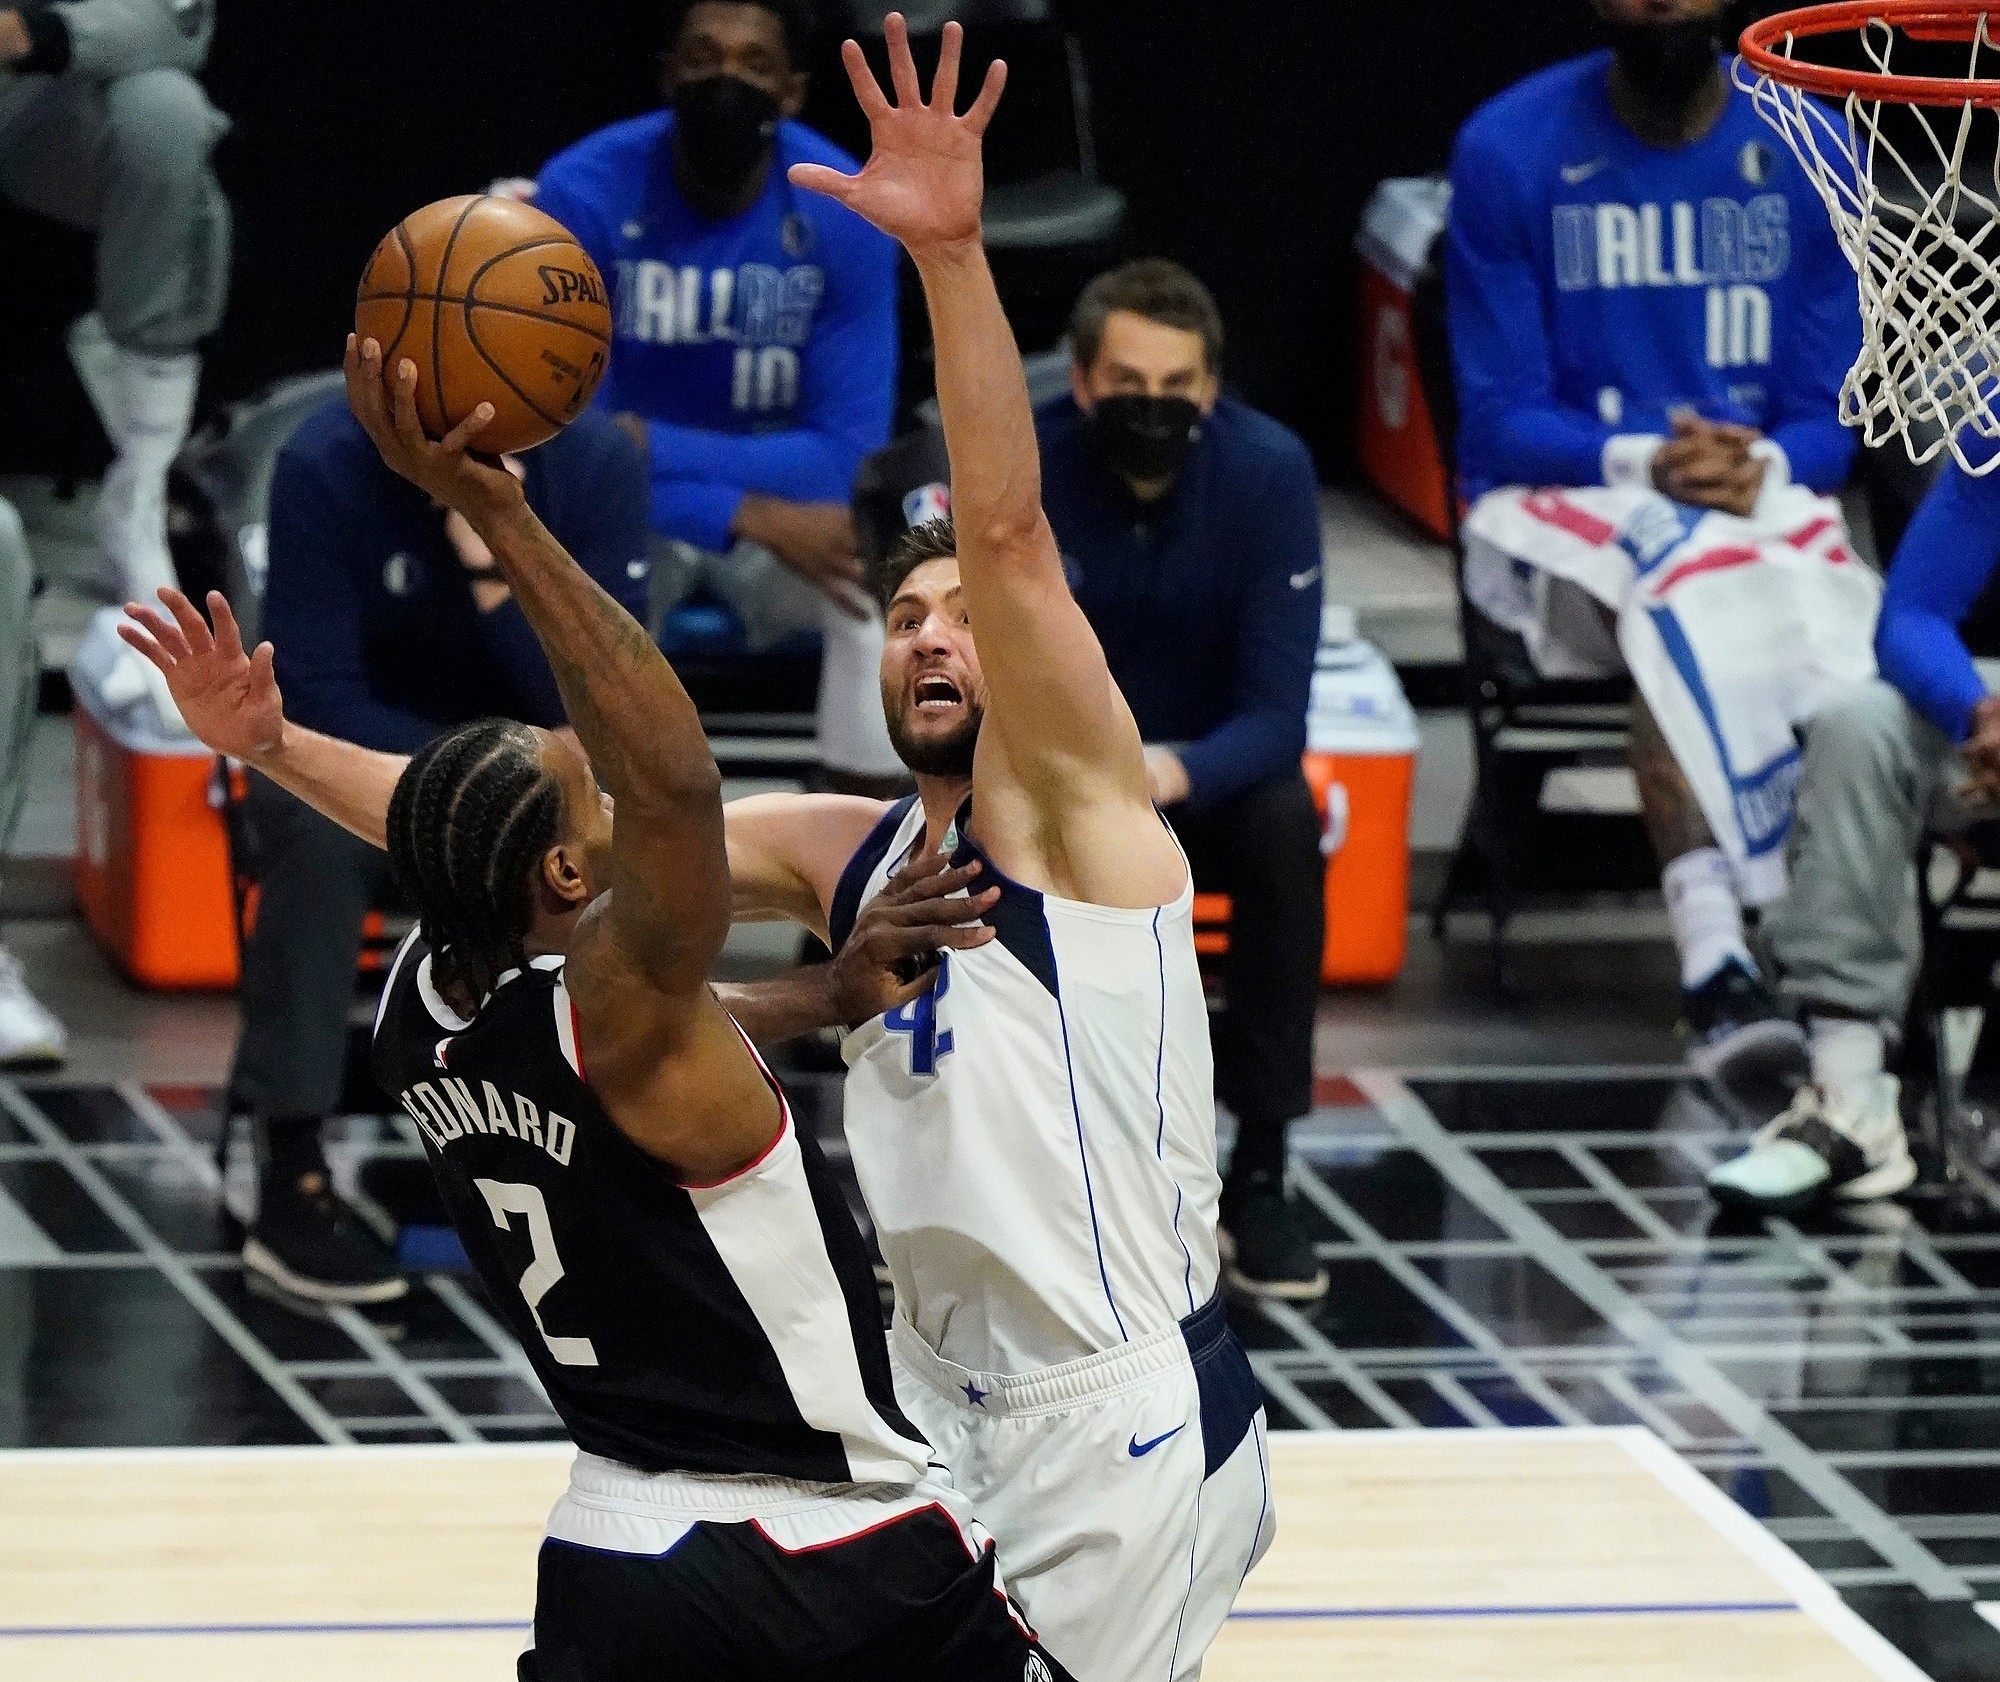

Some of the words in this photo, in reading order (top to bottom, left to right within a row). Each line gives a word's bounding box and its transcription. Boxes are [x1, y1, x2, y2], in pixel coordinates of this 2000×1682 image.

[1704, 283, 1773, 368] IN
[731, 345, 801, 409] IN
[401, 1076, 577, 1167] EONARD
[473, 1177, 600, 1367] 2
